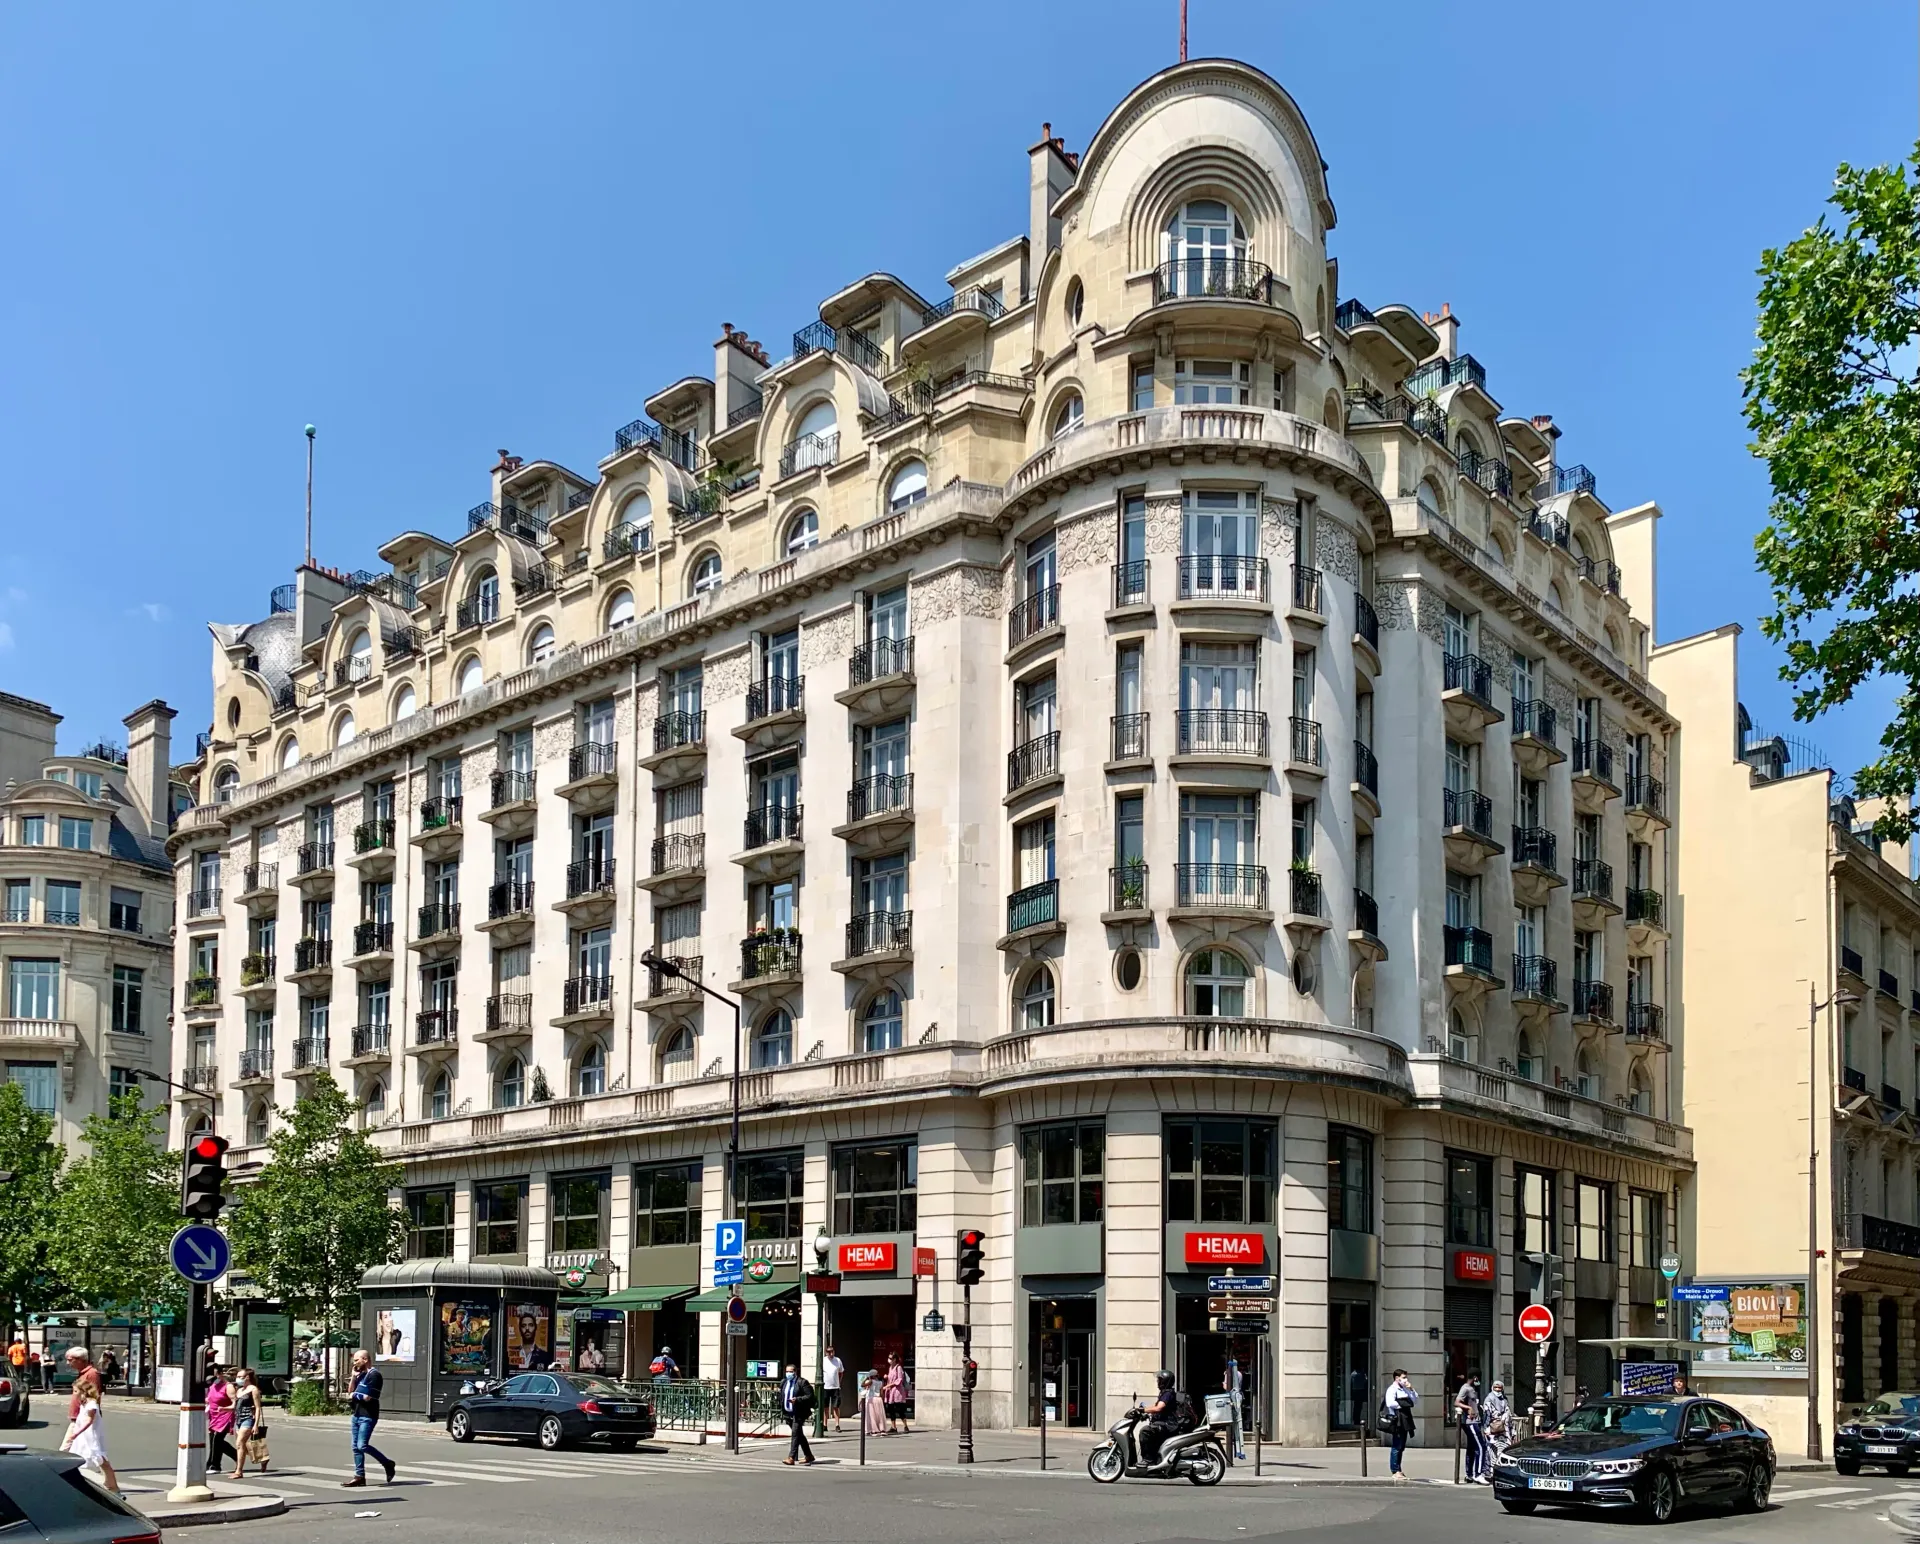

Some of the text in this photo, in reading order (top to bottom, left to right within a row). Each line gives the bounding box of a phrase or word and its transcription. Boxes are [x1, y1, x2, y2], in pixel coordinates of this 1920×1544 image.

[722, 1228, 736, 1251] P
[1197, 1237, 1251, 1253] HEMA
[847, 1247, 884, 1263] HEMA
[918, 1257, 935, 1266] HEMA
[1662, 1259, 1678, 1267] BUS
[1465, 1256, 1489, 1272] HEMA
